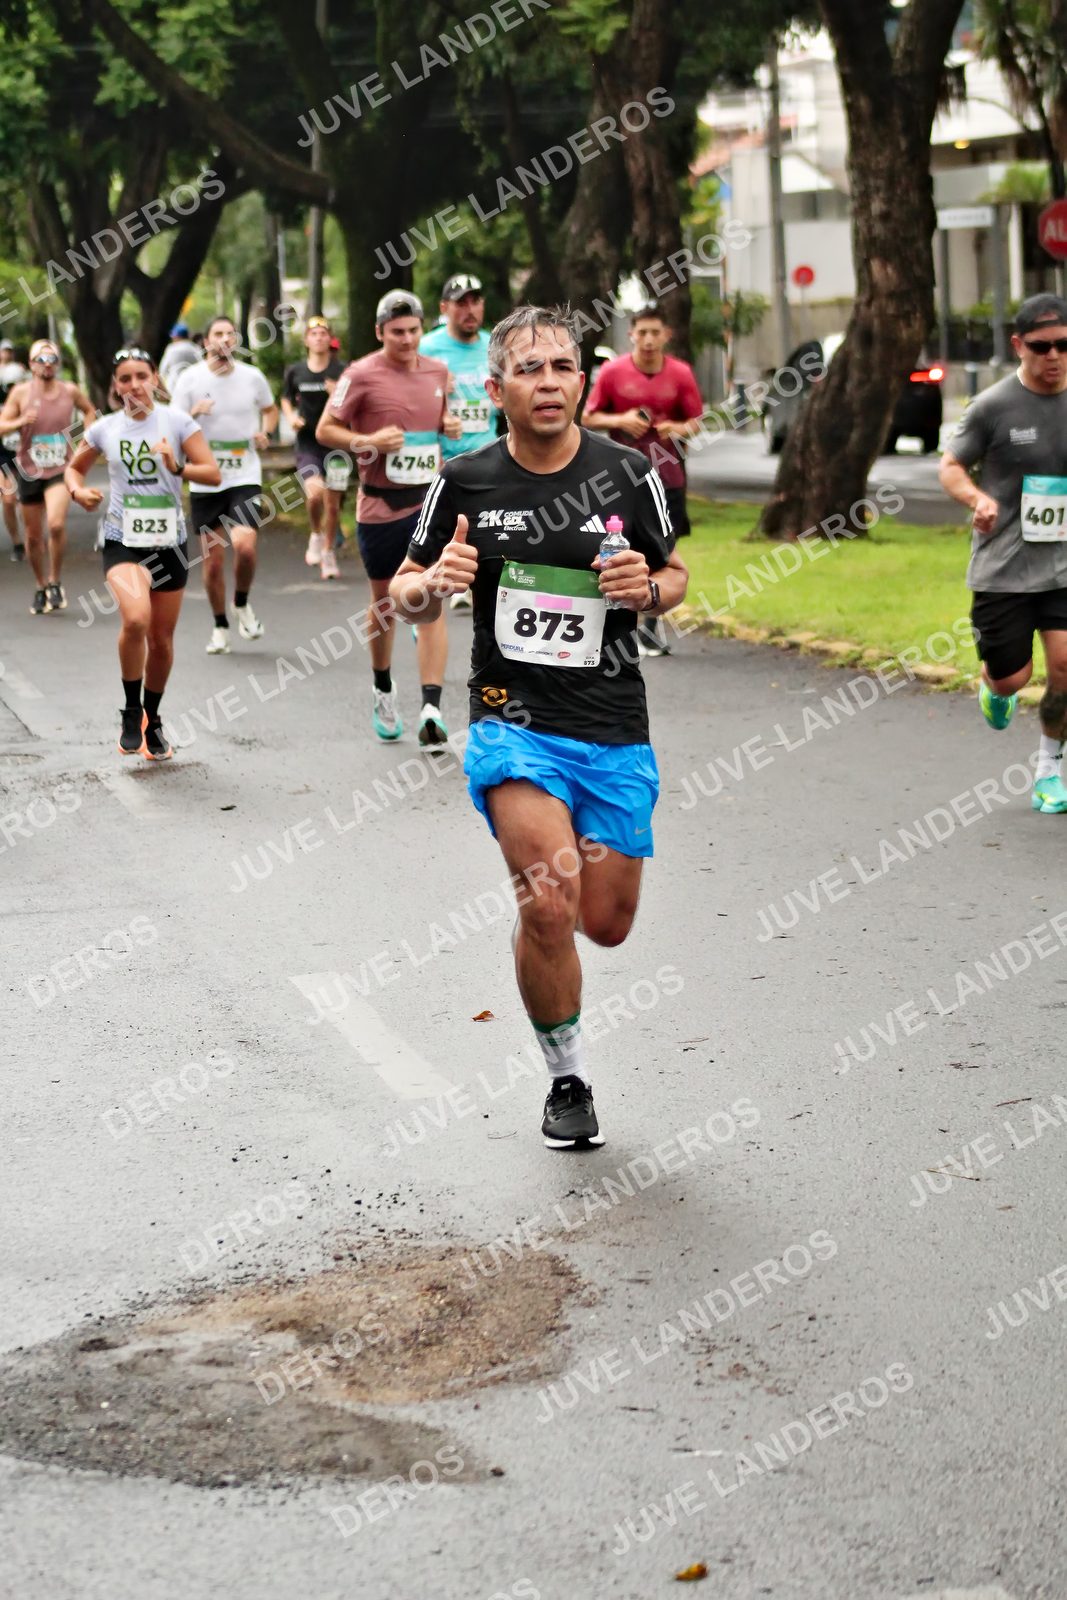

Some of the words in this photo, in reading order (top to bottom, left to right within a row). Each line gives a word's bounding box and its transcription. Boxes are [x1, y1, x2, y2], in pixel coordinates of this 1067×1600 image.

[121, 457, 157, 476] YO
[390, 455, 436, 471] 4748
[132, 518, 168, 533] 823
[514, 608, 585, 643] 873
